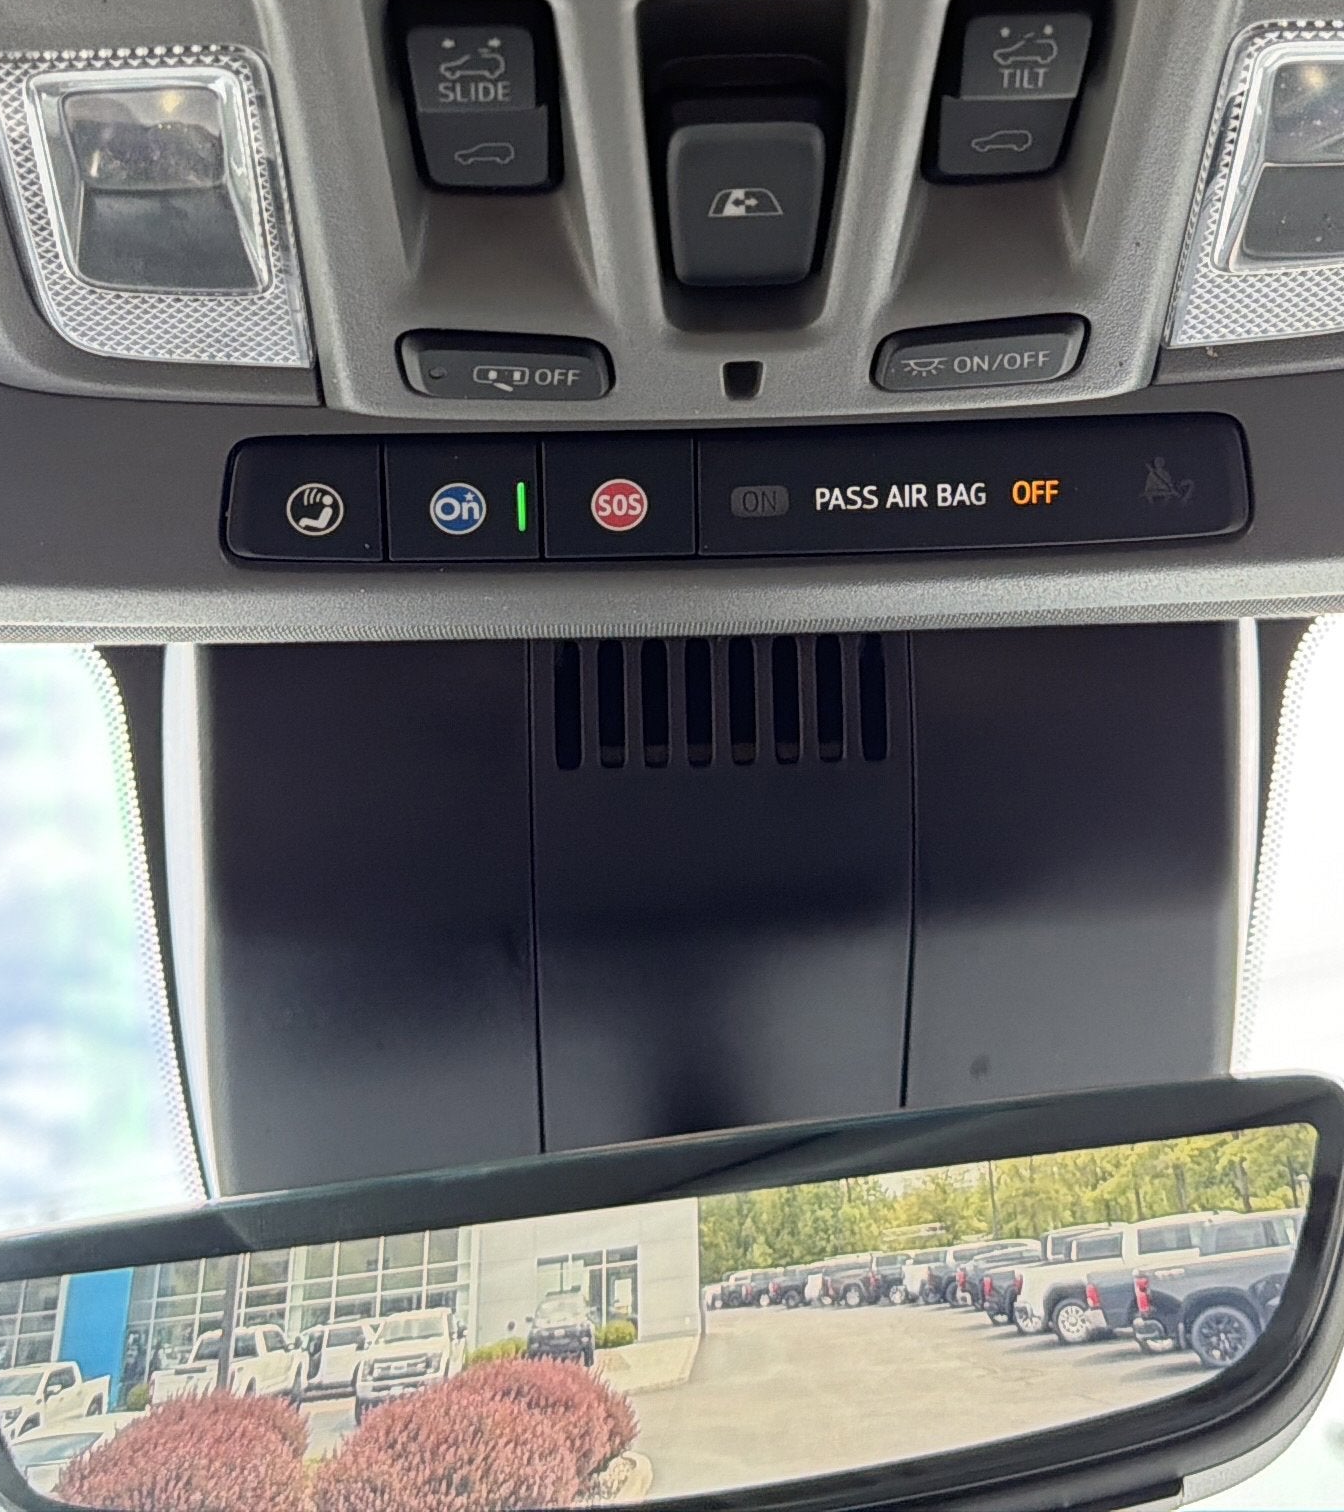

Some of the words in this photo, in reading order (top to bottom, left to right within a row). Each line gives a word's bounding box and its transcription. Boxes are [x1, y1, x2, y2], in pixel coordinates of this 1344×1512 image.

[998, 68, 1050, 89] TILT
[437, 80, 512, 103] SLIDE
[953, 350, 1051, 374] ON/OFF
[534, 368, 581, 387] OFF
[597, 493, 642, 518] SOS
[741, 489, 777, 513] ON
[814, 485, 880, 511] PASS
[885, 484, 929, 509] AIR
[936, 482, 988, 507] BAG
[1011, 479, 1060, 505] OFF
[434, 496, 480, 521] On
